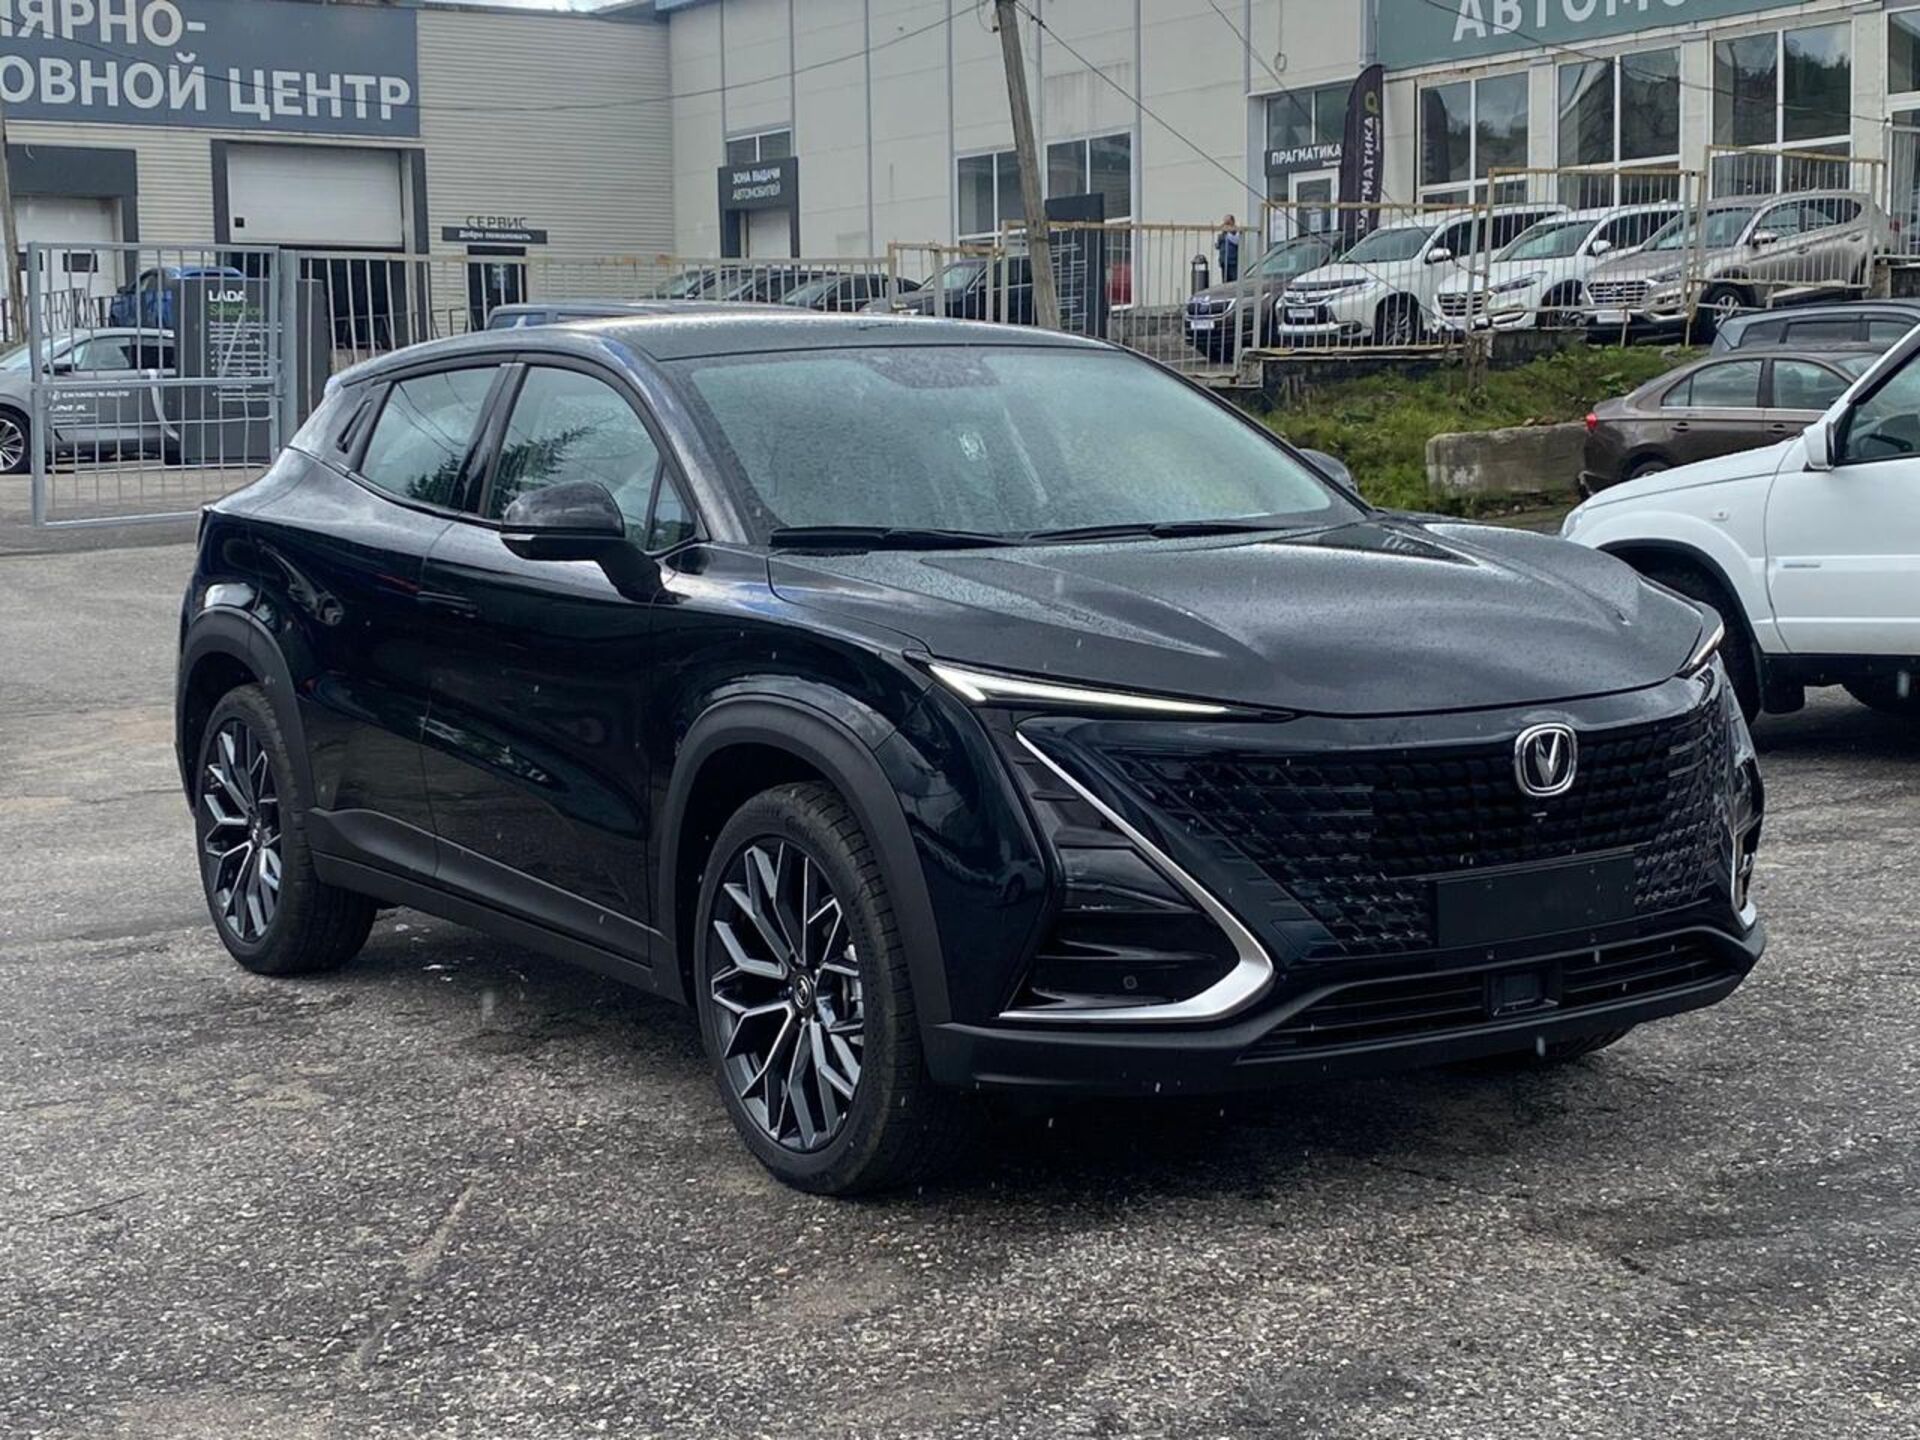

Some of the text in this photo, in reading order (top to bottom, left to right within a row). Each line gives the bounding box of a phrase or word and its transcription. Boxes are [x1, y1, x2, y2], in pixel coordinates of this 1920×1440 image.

[0, 52, 411, 121] ОВНОЙ ЦЕНТР
[1271, 143, 1342, 165] ПРАГМАТИКА
[465, 216, 528, 229] СЕРВИС
[208, 290, 247, 302] LADA
